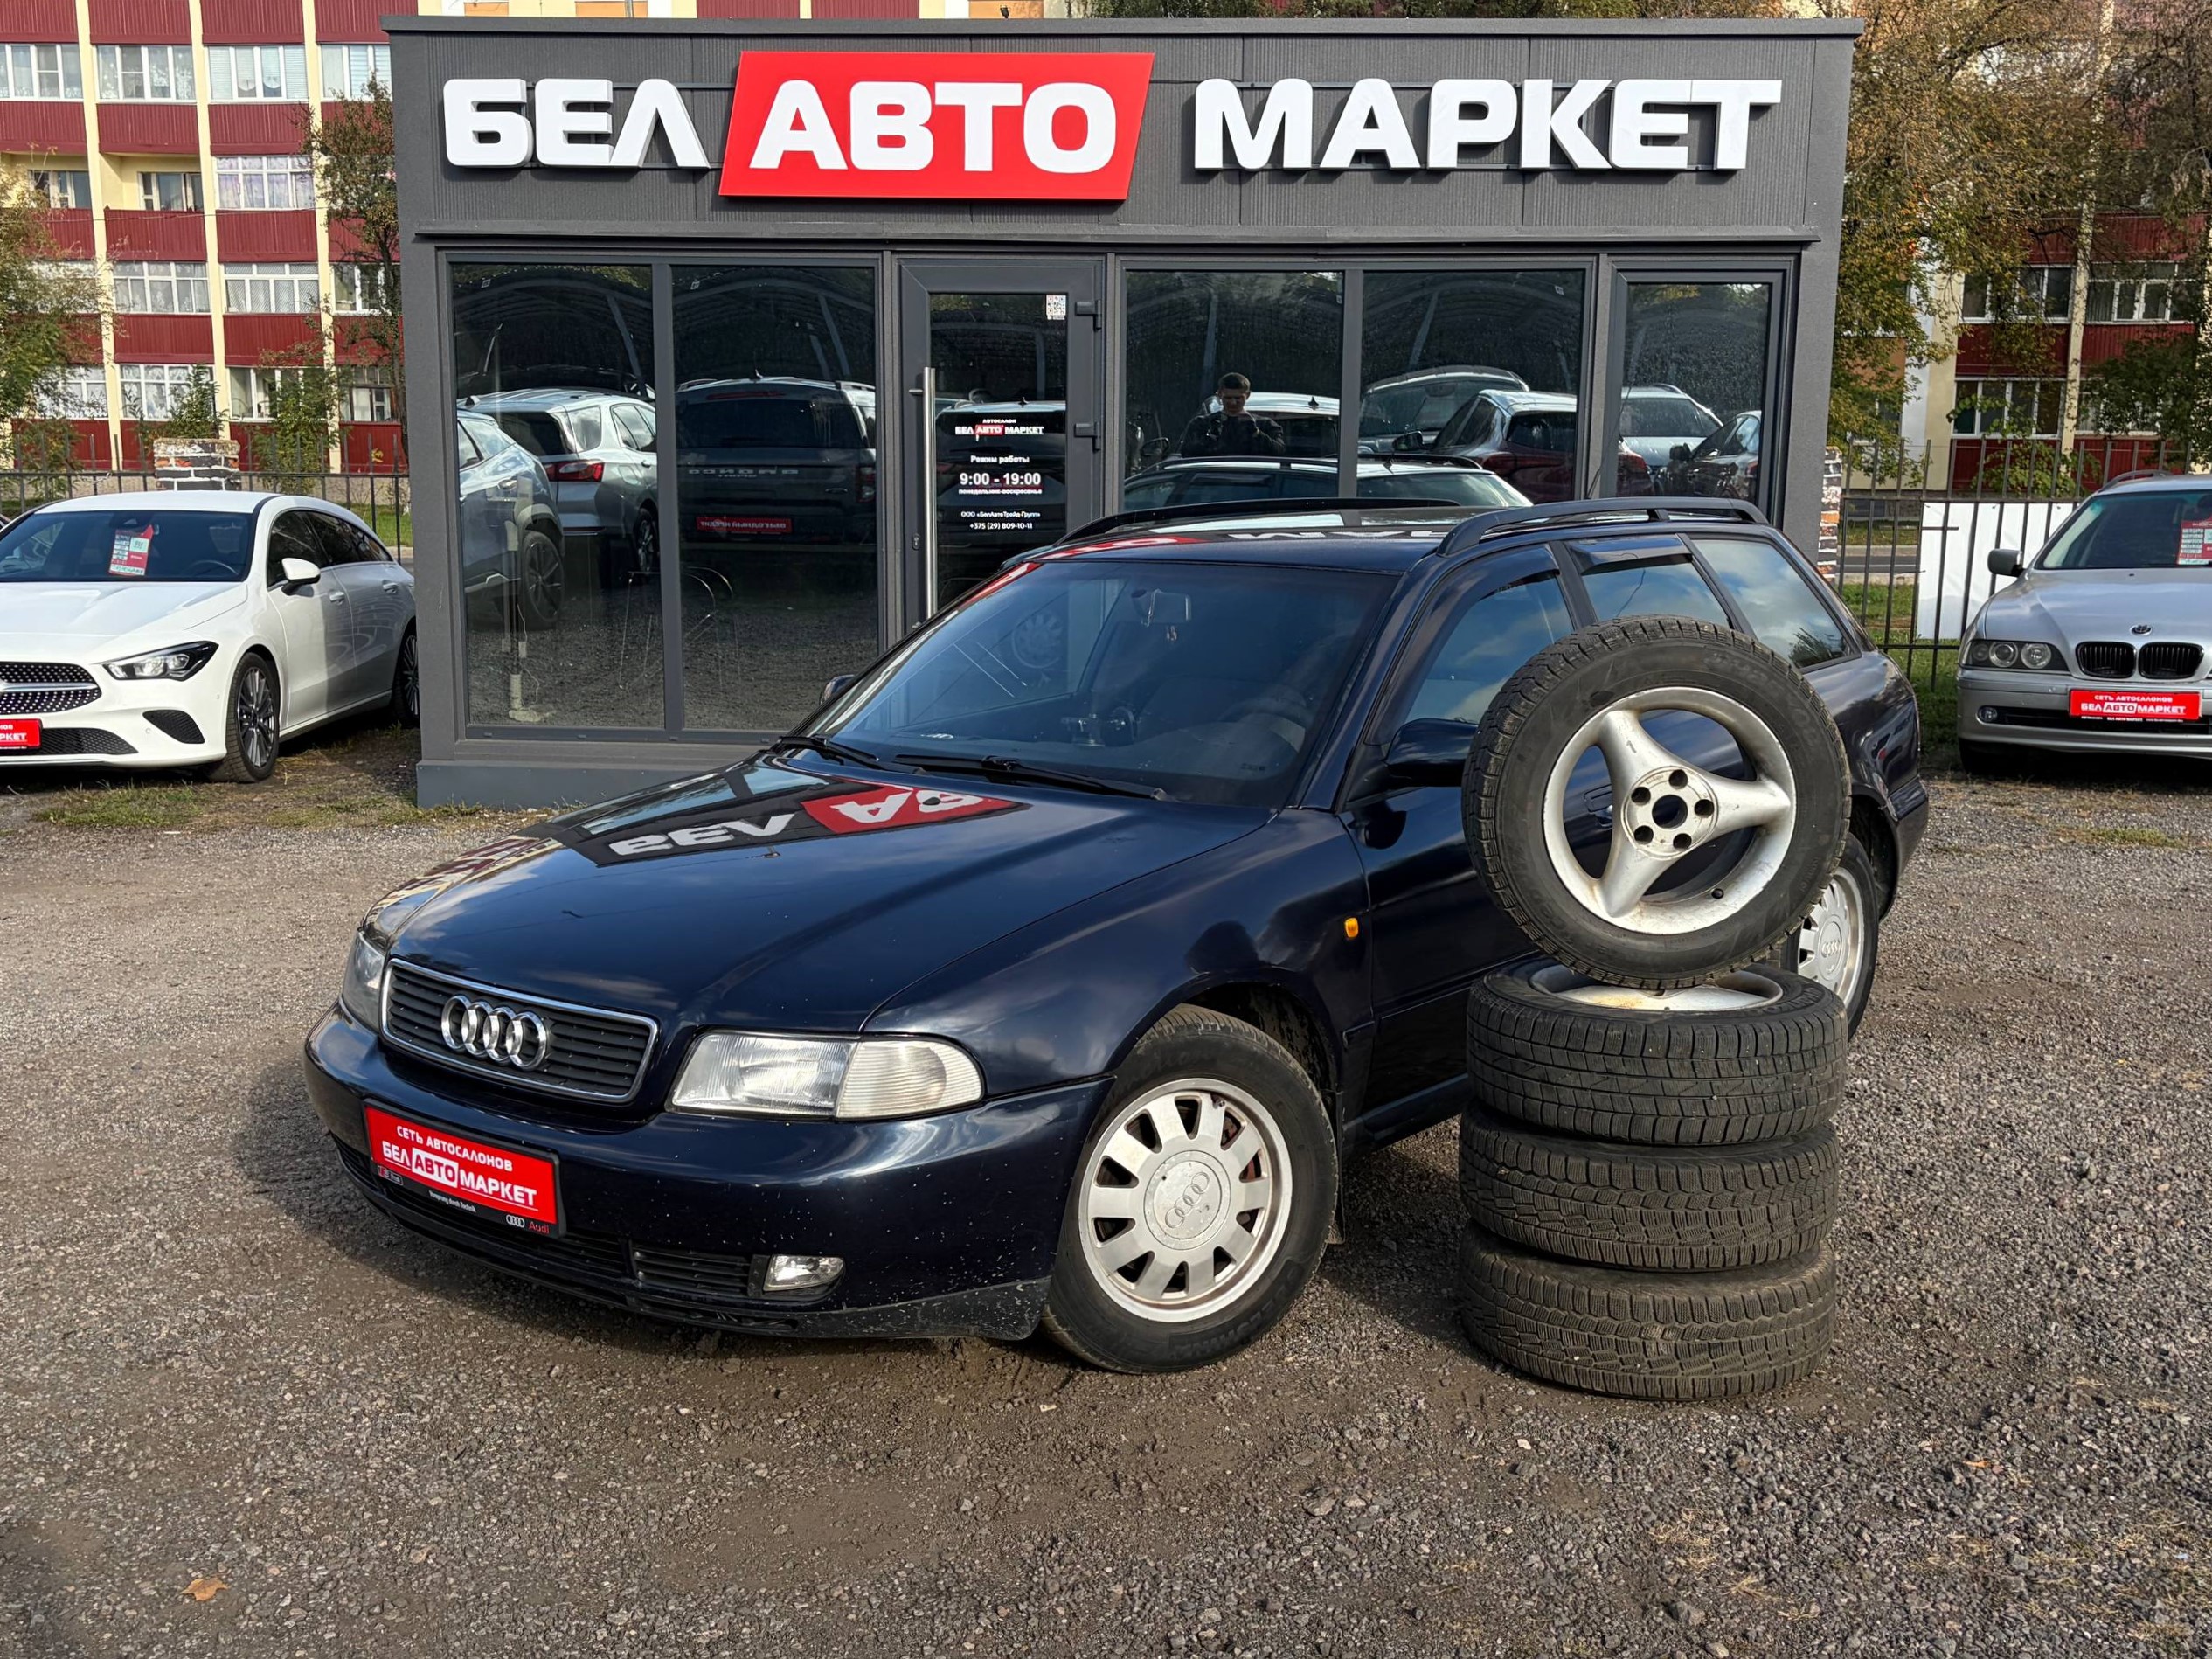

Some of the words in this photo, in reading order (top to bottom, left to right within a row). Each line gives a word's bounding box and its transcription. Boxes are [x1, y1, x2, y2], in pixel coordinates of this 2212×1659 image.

[443, 78, 711, 170] БЕЛ
[749, 79, 1117, 174] АВТО
[1194, 77, 1782, 171] МАРКЕТ
[954, 426, 974, 435] БЕЛ
[976, 426, 1002, 434] АВТО
[1004, 426, 1044, 435] МАРКЕТ
[970, 455, 997, 463] Режим
[999, 455, 1030, 464] работы
[960, 472, 990, 486] 9:00
[1002, 472, 1042, 486] 19:00
[2081, 703, 2102, 711] БЕЛ
[2137, 705, 2187, 714] МАРКЕТ
[397, 1125, 424, 1145] СЕТЬ
[426, 1135, 513, 1172] АВТОСАЛОНОВ
[382, 1140, 412, 1167] БЕЛ
[414, 1154, 456, 1183] АВТО
[459, 1169, 537, 1206] МАРКЕТ
[529, 1221, 550, 1234] Audi
